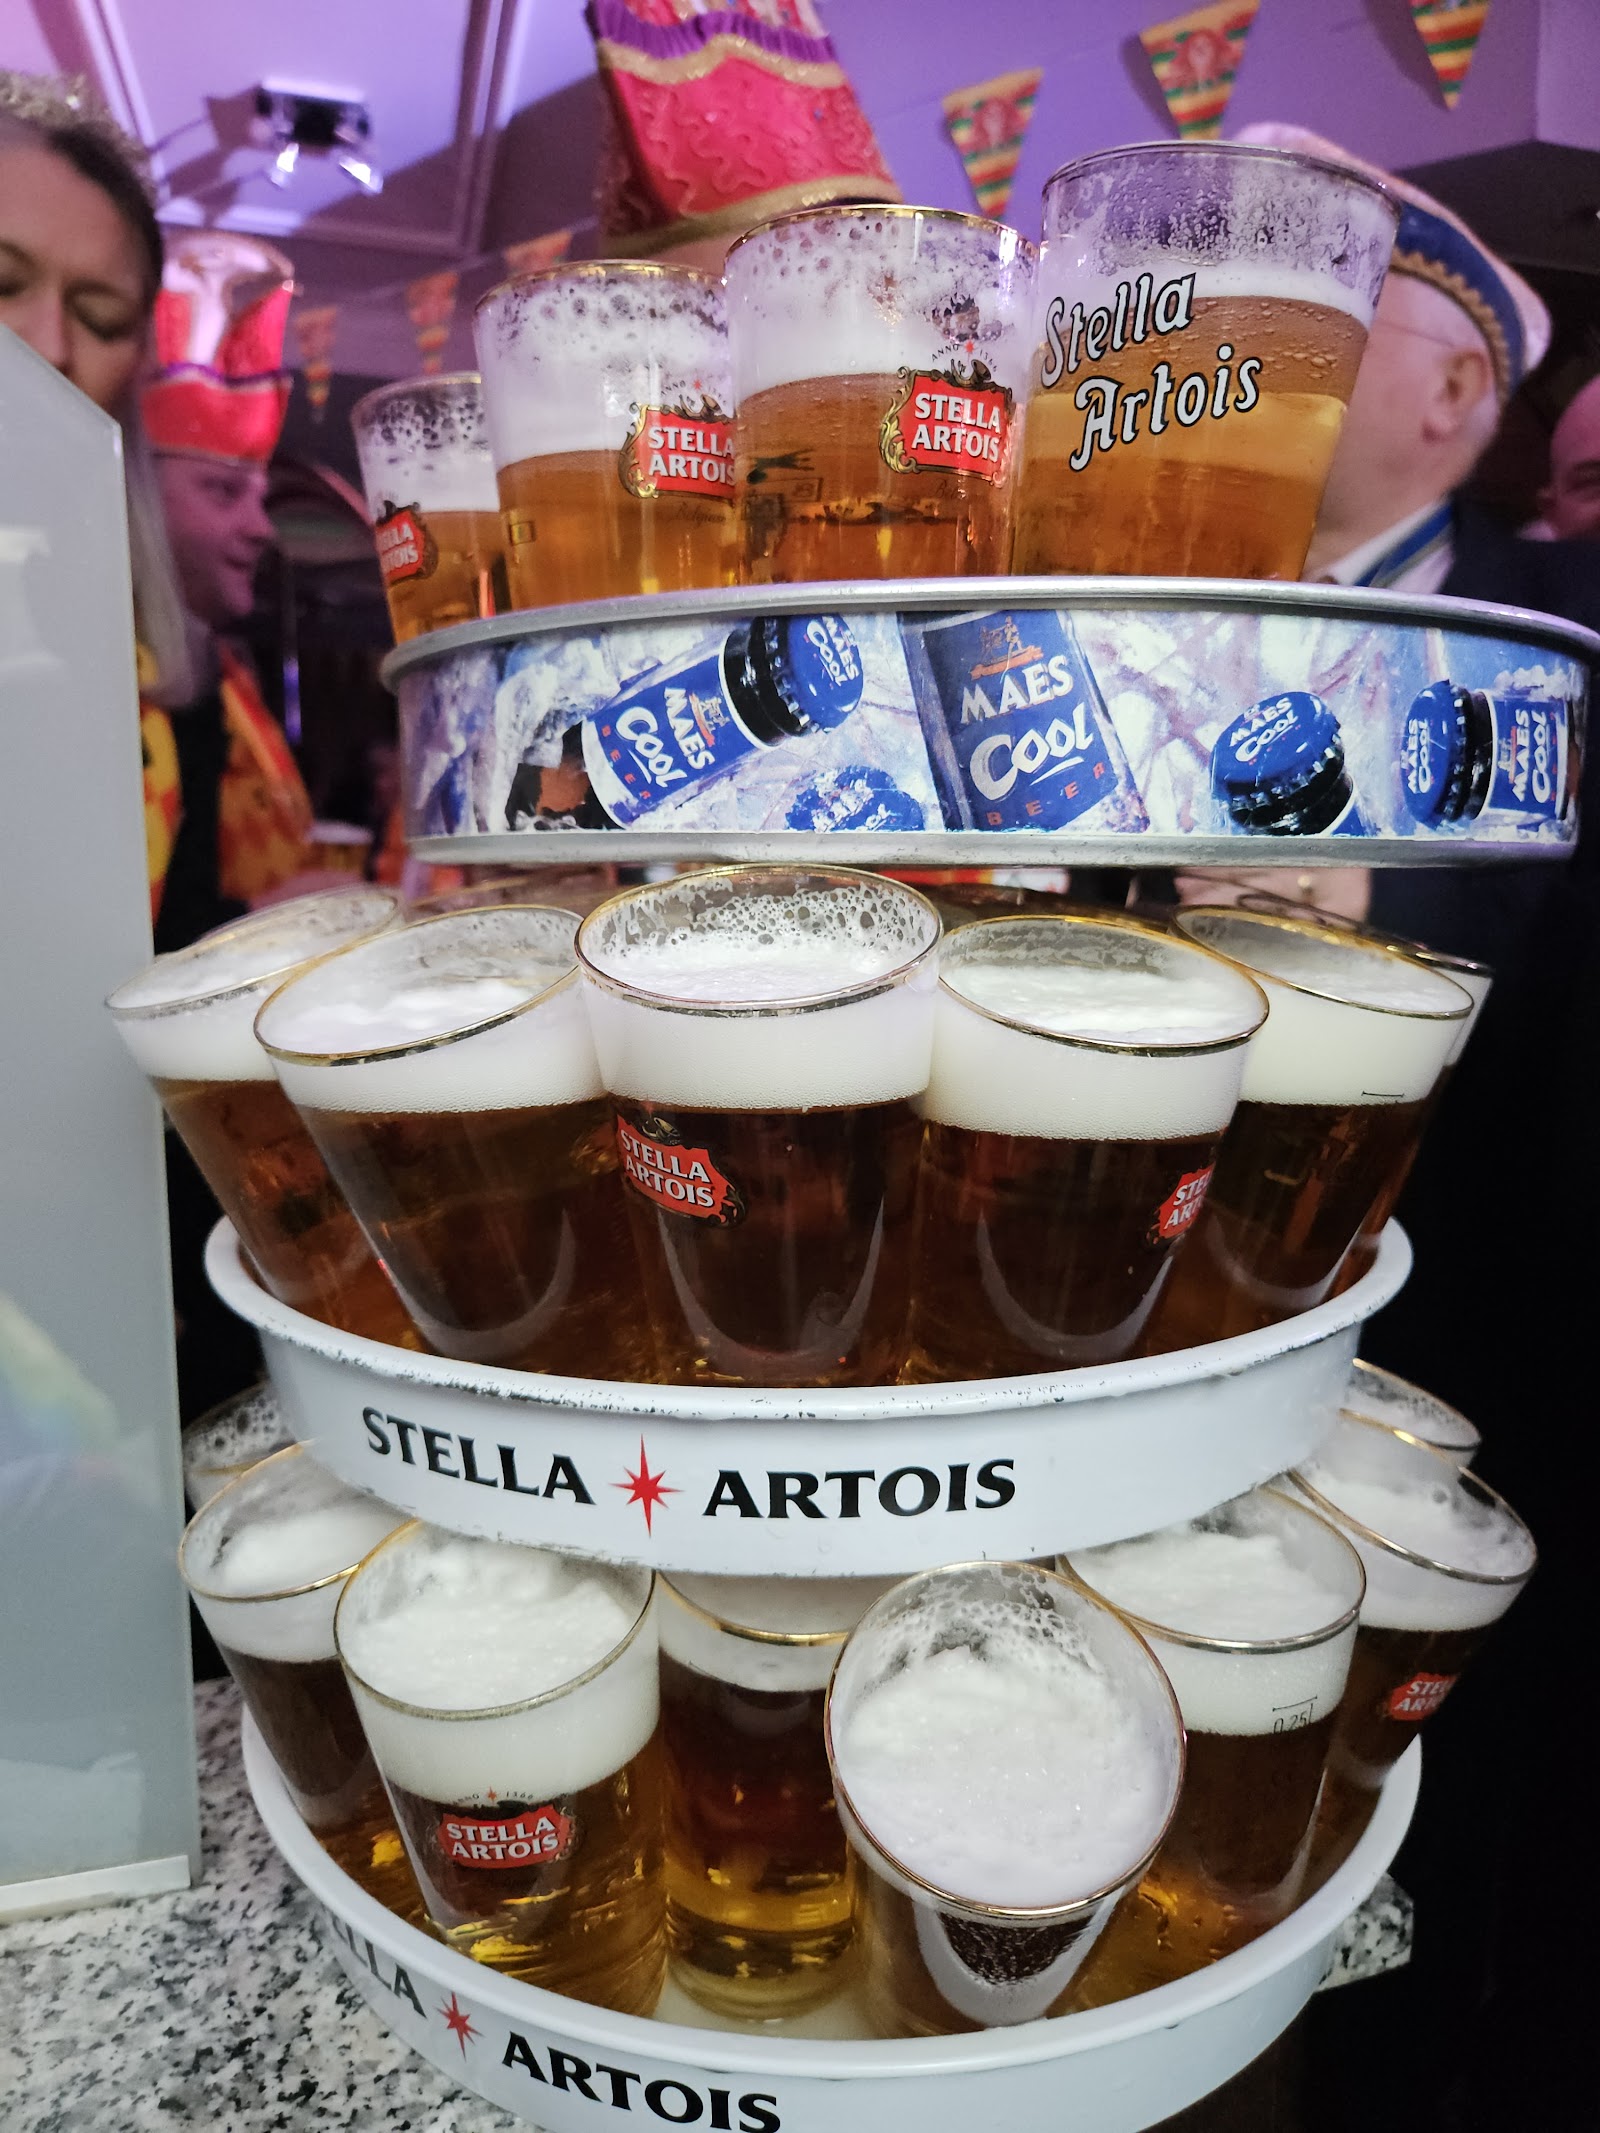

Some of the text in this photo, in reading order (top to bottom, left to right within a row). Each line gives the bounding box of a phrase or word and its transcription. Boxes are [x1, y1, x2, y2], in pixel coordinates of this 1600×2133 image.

[931, 344, 960, 361] ANNO
[1041, 272, 1196, 389] Stella
[914, 393, 1000, 433] STELLA
[1069, 343, 1263, 472] Artois
[911, 424, 1000, 463] ARTOIS
[961, 655, 1073, 723] MAES
[664, 687, 715, 769] MAES
[1229, 697, 1292, 747] MAES
[1512, 709, 1530, 802] MAES
[621, 1129, 711, 1183] STELLA
[626, 1155, 714, 1207] ARTOIS
[362, 1406, 1017, 1519] STELLA ARTOIS
[446, 1816, 556, 1842] STELLA
[452, 1833, 559, 1860] ARTOIS
[502, 2031, 781, 2133] ARTOIS
